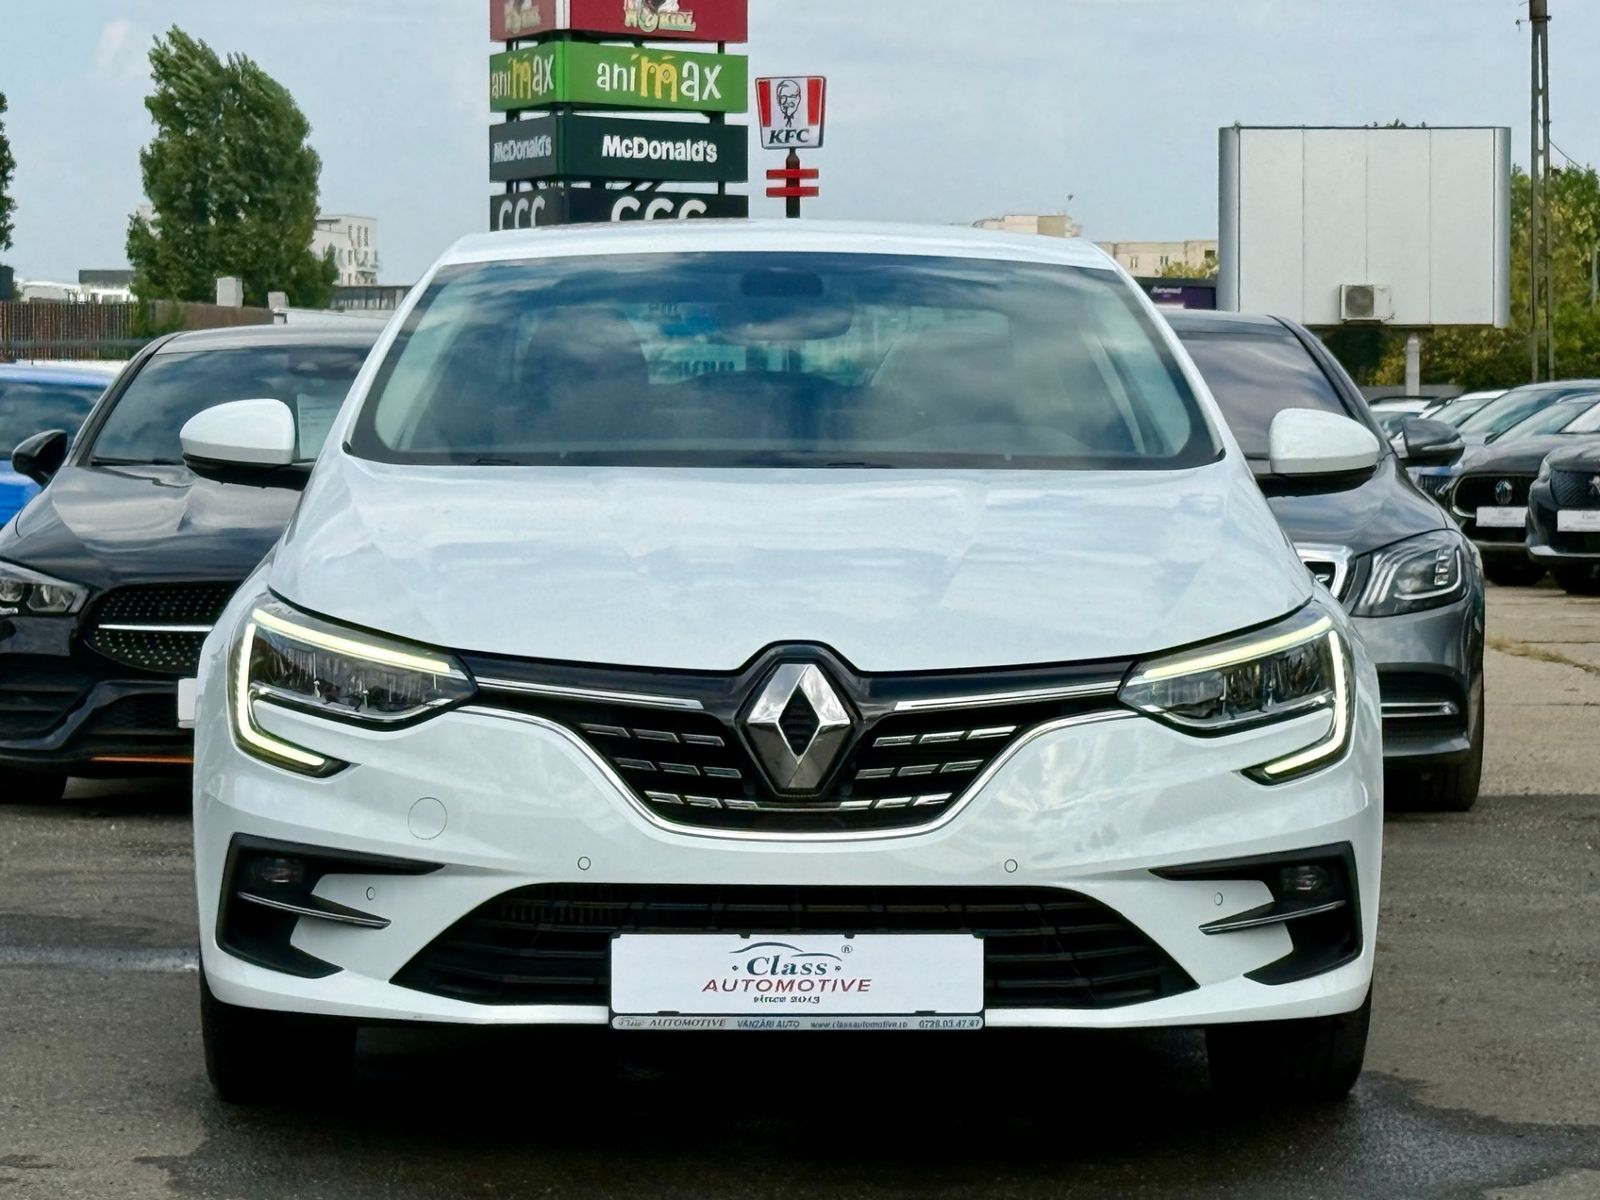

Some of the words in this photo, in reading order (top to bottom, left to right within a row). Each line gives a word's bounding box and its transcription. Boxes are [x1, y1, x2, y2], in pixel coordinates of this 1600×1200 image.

[769, 128, 810, 144] KFC
[493, 135, 552, 163] McDonald's
[602, 134, 718, 163] McDonald's
[746, 955, 828, 976] Class
[702, 978, 872, 993] AUTOMOTIVE
[753, 994, 786, 1003] since
[790, 996, 821, 1004] 2013
[650, 1019, 726, 1027] AUTOMOTIVE
[776, 1020, 800, 1028] AUTO
